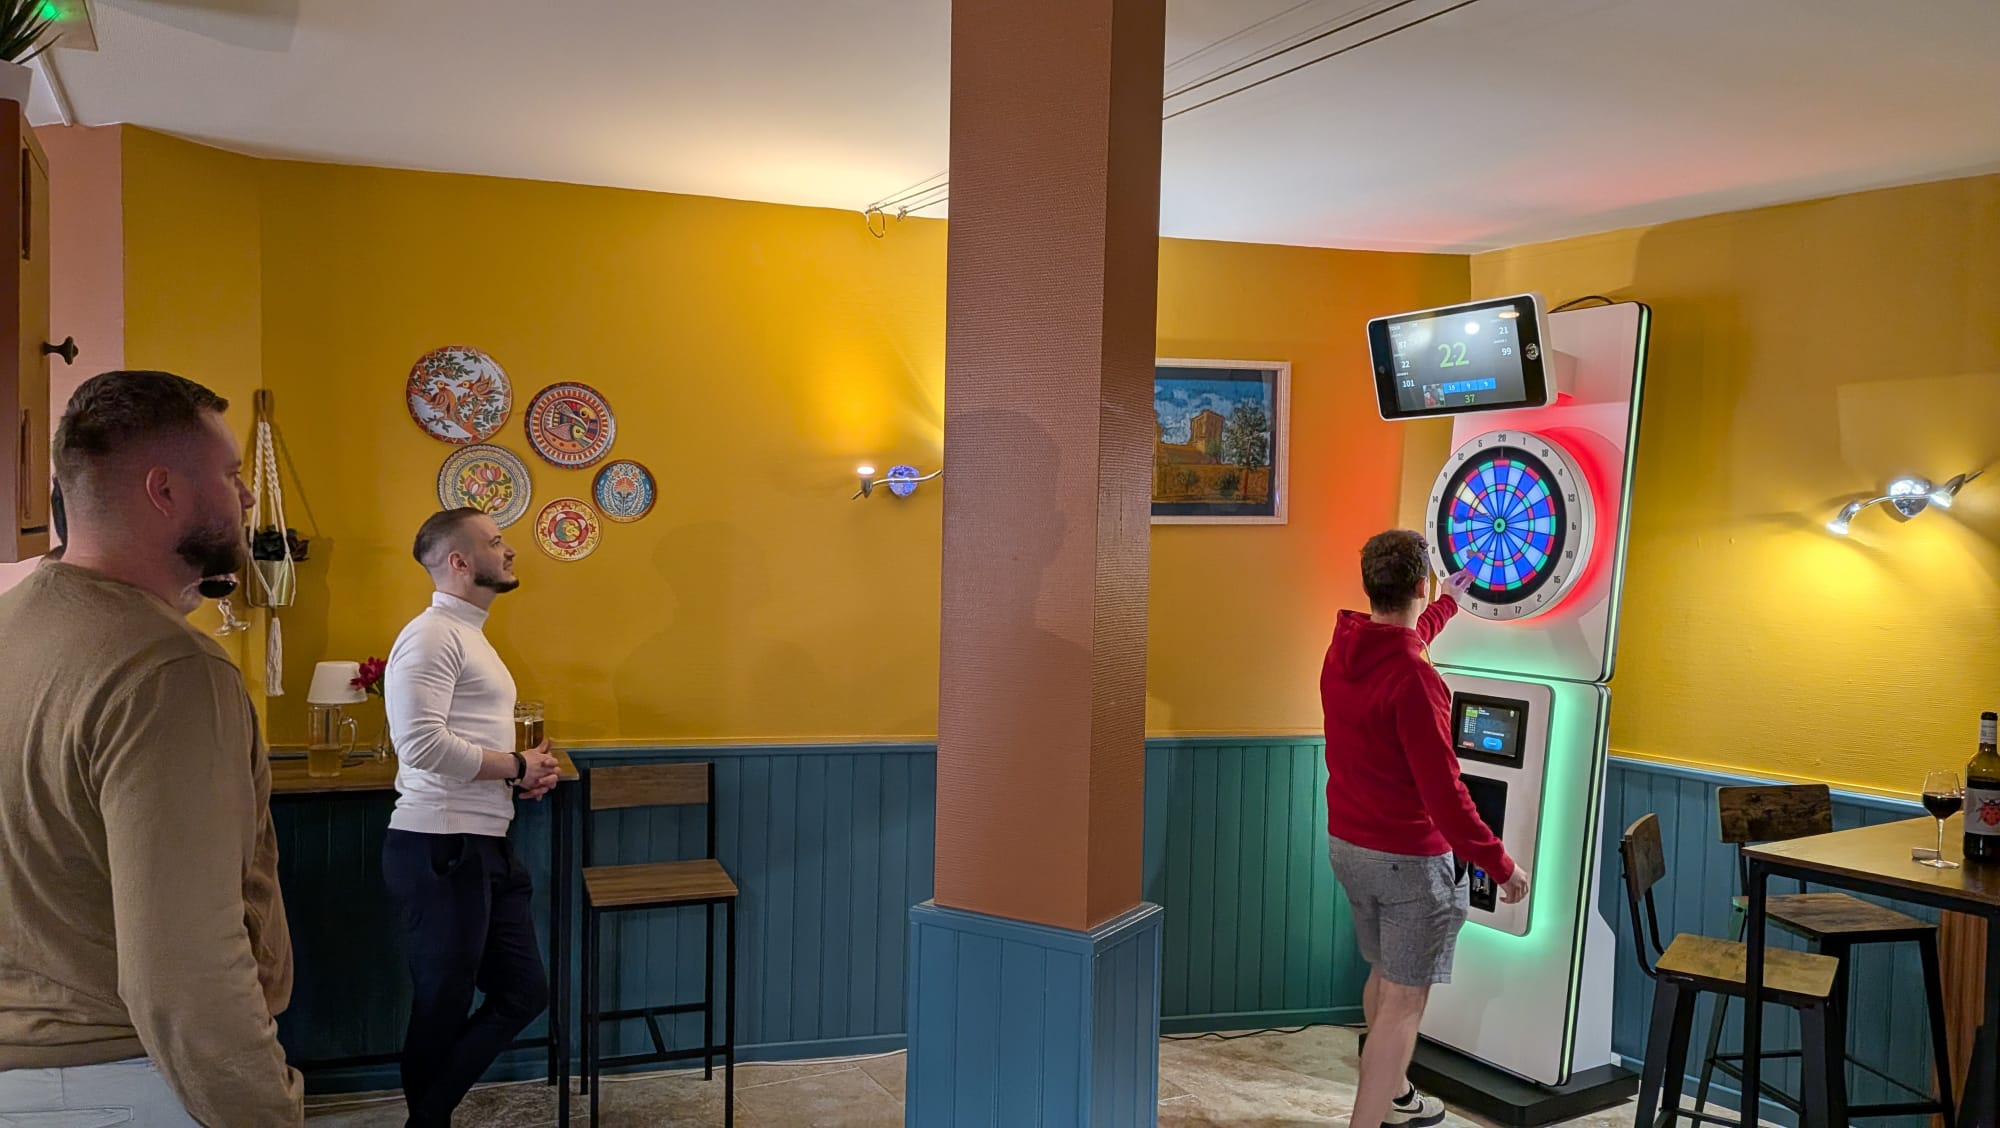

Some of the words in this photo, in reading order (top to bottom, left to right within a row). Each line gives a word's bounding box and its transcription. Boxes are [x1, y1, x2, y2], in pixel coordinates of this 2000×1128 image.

[1438, 342, 1469, 368] 22
[1402, 380, 1415, 388] 101
[1465, 394, 1475, 403] 37
[1498, 434, 1506, 442] 20
[1458, 452, 1464, 460] 12
[1542, 449, 1548, 457] 18
[1568, 494, 1575, 502] 13
[1572, 522, 1576, 530] 6
[1494, 608, 1498, 616] 3
